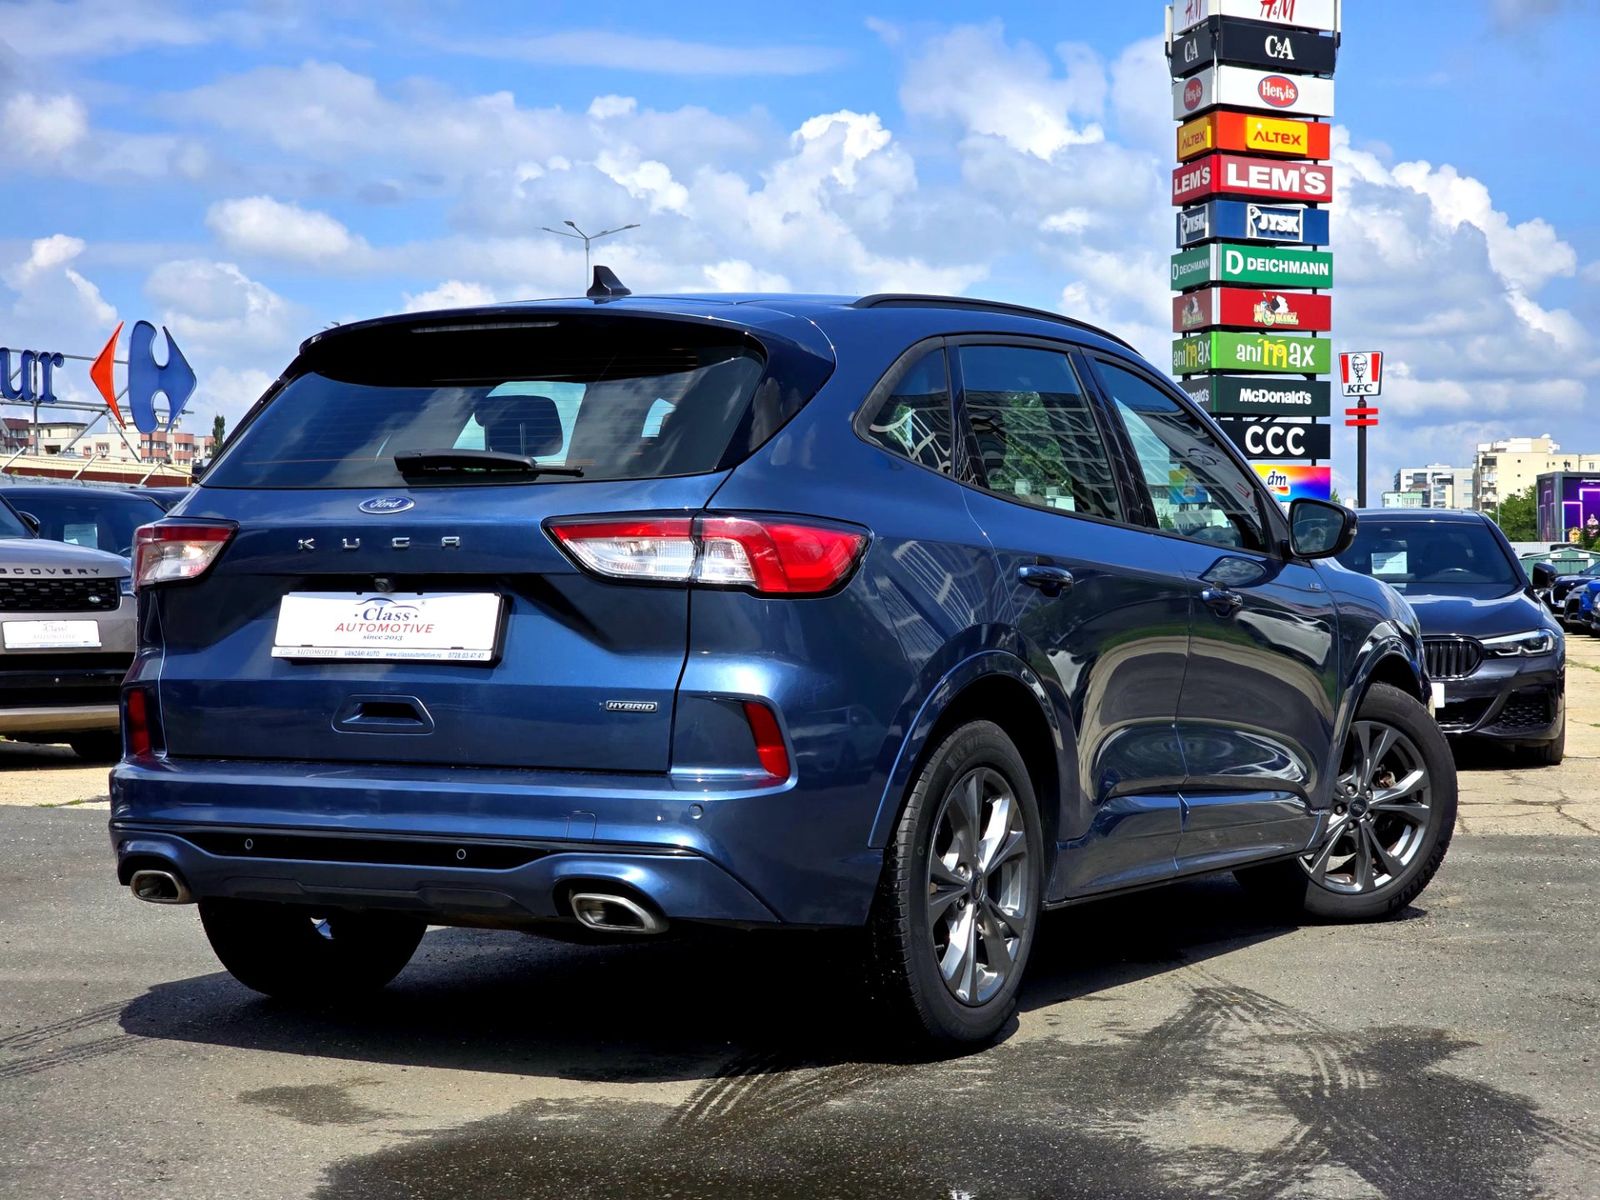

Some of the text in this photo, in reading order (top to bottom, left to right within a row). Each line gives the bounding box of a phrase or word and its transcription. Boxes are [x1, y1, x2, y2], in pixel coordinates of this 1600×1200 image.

[1265, 35, 1295, 60] C&A
[1262, 81, 1296, 101] Hervis
[1174, 165, 1211, 196] LEM'S
[1227, 163, 1327, 195] LEM'S
[1257, 213, 1299, 233] JYSK
[1179, 257, 1210, 275] DEICHMANN
[1226, 250, 1329, 276] D DEICHMANN
[1173, 339, 1211, 368] animax
[1236, 339, 1315, 368] animax
[0, 347, 64, 404] ur
[1239, 388, 1312, 405] McDonald's
[1346, 383, 1373, 394] KFC
[1245, 425, 1306, 455] CCC
[1267, 470, 1287, 486] dm
[370, 499, 402, 509] Ford
[298, 536, 461, 550] KUGA
[362, 607, 411, 622] Class
[335, 622, 435, 634] AUTOMOTIVE
[384, 634, 404, 642] 2013
[608, 702, 654, 710] HYBRID
